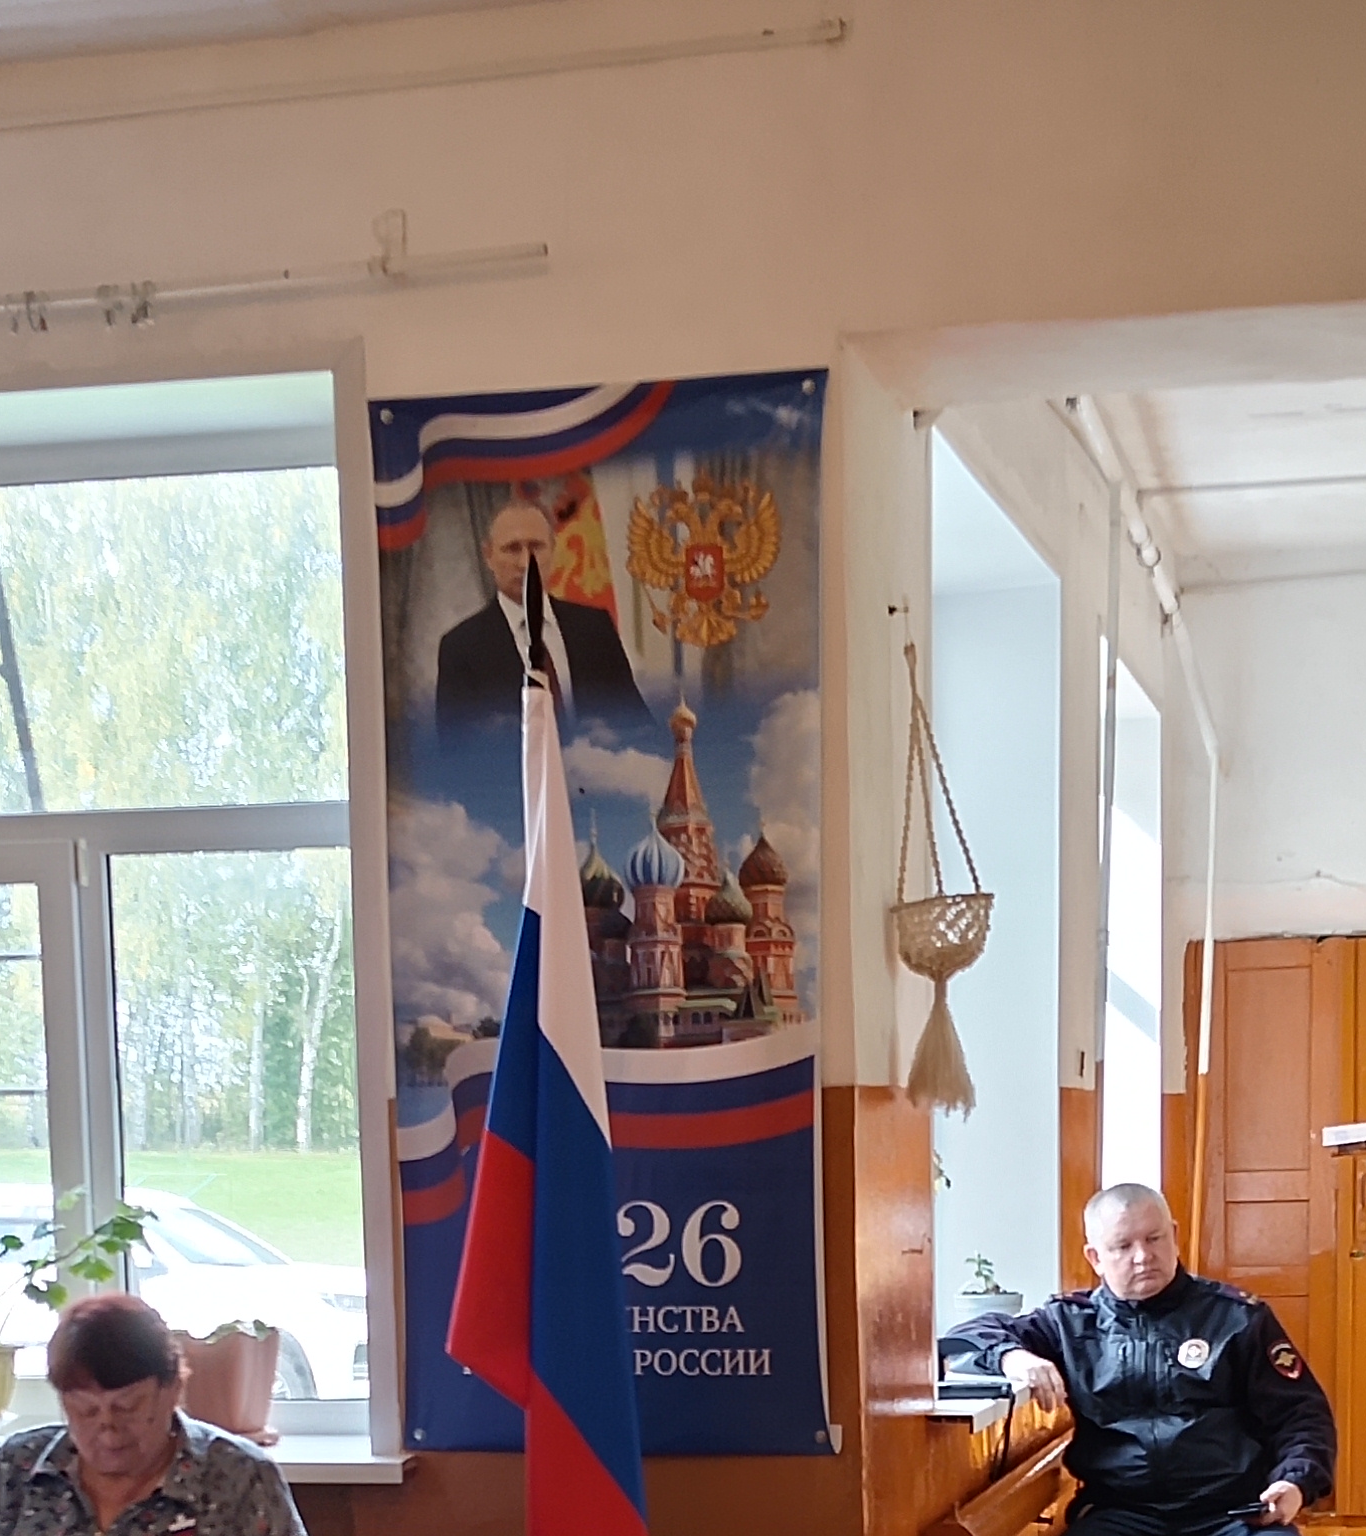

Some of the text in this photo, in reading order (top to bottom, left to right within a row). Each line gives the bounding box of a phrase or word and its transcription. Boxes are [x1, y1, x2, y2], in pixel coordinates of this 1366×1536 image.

[616, 1200, 742, 1287] 26
[625, 1305, 745, 1333] НСТВА
[633, 1349, 772, 1376] РОССИИ
